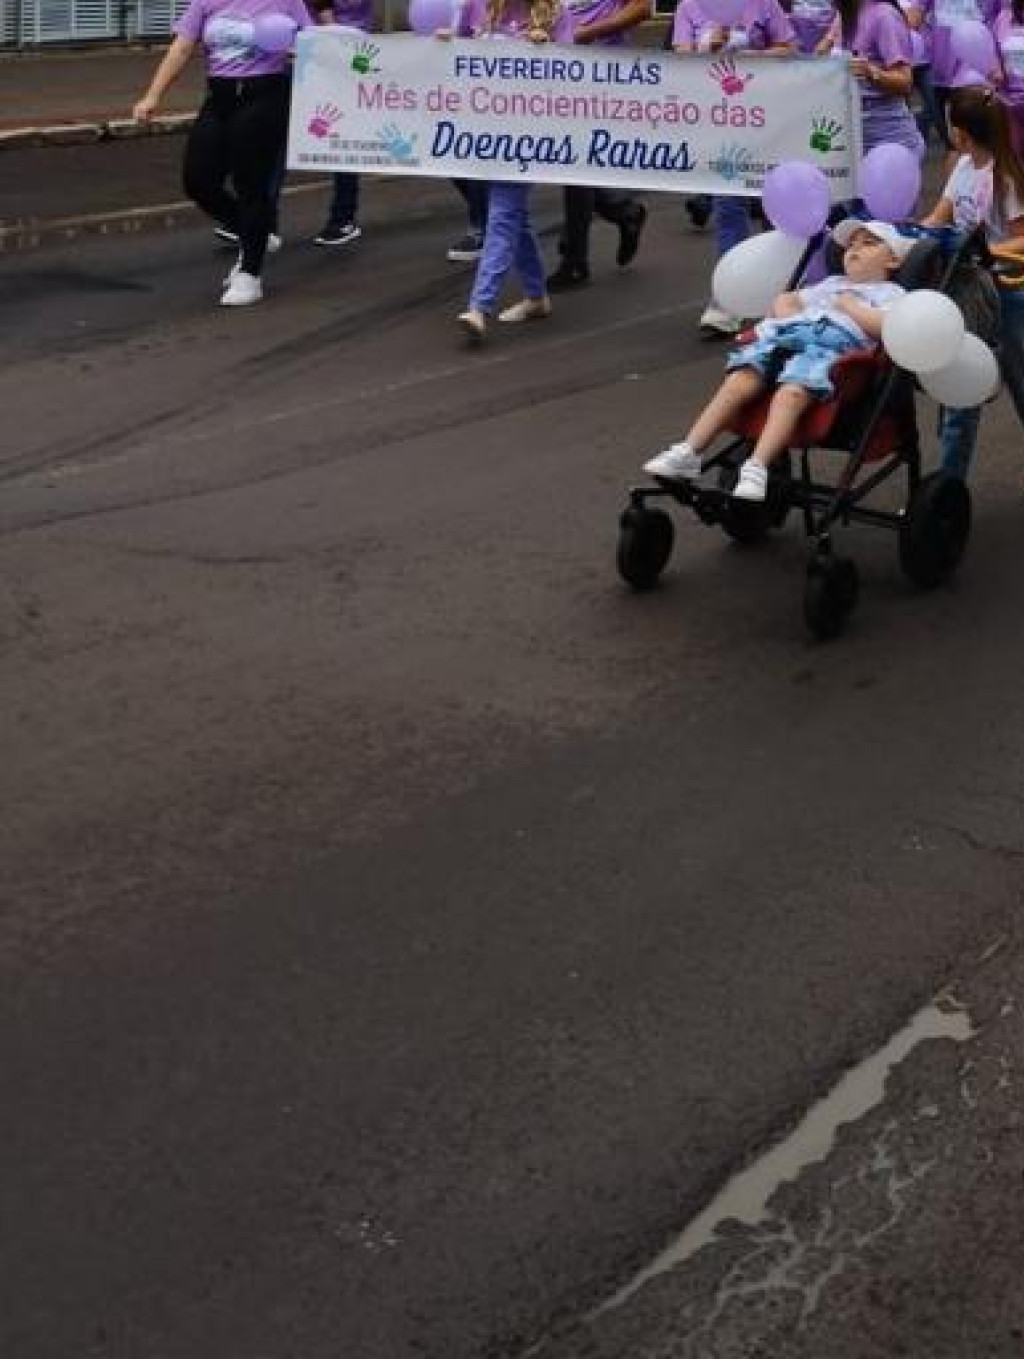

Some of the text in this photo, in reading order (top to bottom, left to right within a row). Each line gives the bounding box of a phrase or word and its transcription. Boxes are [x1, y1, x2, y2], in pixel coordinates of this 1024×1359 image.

[455, 54, 662, 85] FEVEREIRO LILÁS
[357, 81, 765, 129] Mês de Concientização das
[431, 121, 697, 172] Doenças Raras
